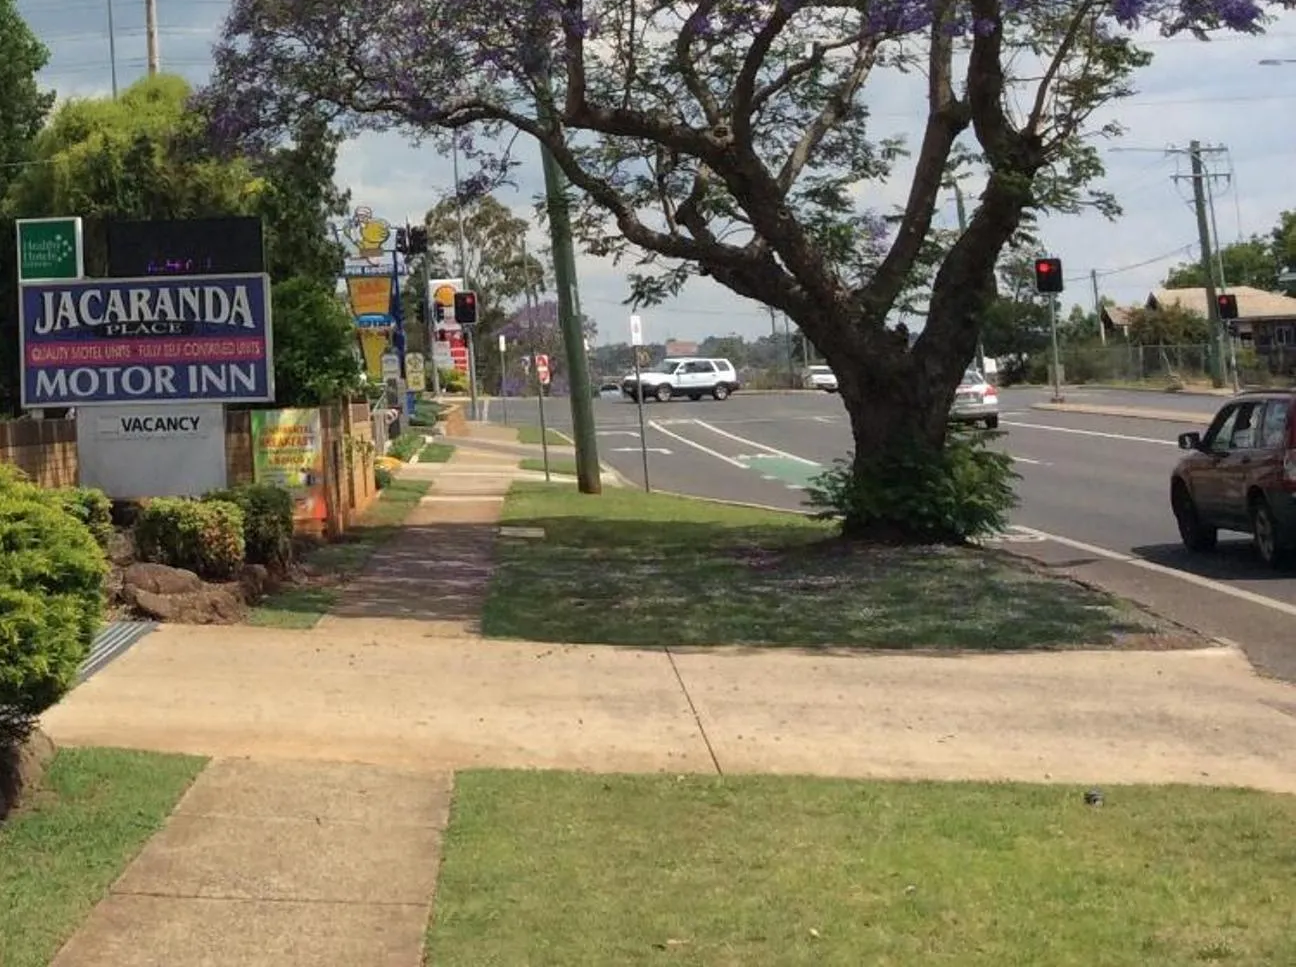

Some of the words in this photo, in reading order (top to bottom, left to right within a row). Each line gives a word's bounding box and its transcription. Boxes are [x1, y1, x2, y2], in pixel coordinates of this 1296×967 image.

[34, 284, 257, 334] JACARANDA
[106, 322, 183, 336] PLACE
[35, 365, 177, 397] MOTOR
[187, 363, 256, 393] INN
[120, 415, 201, 433] VACANCY
